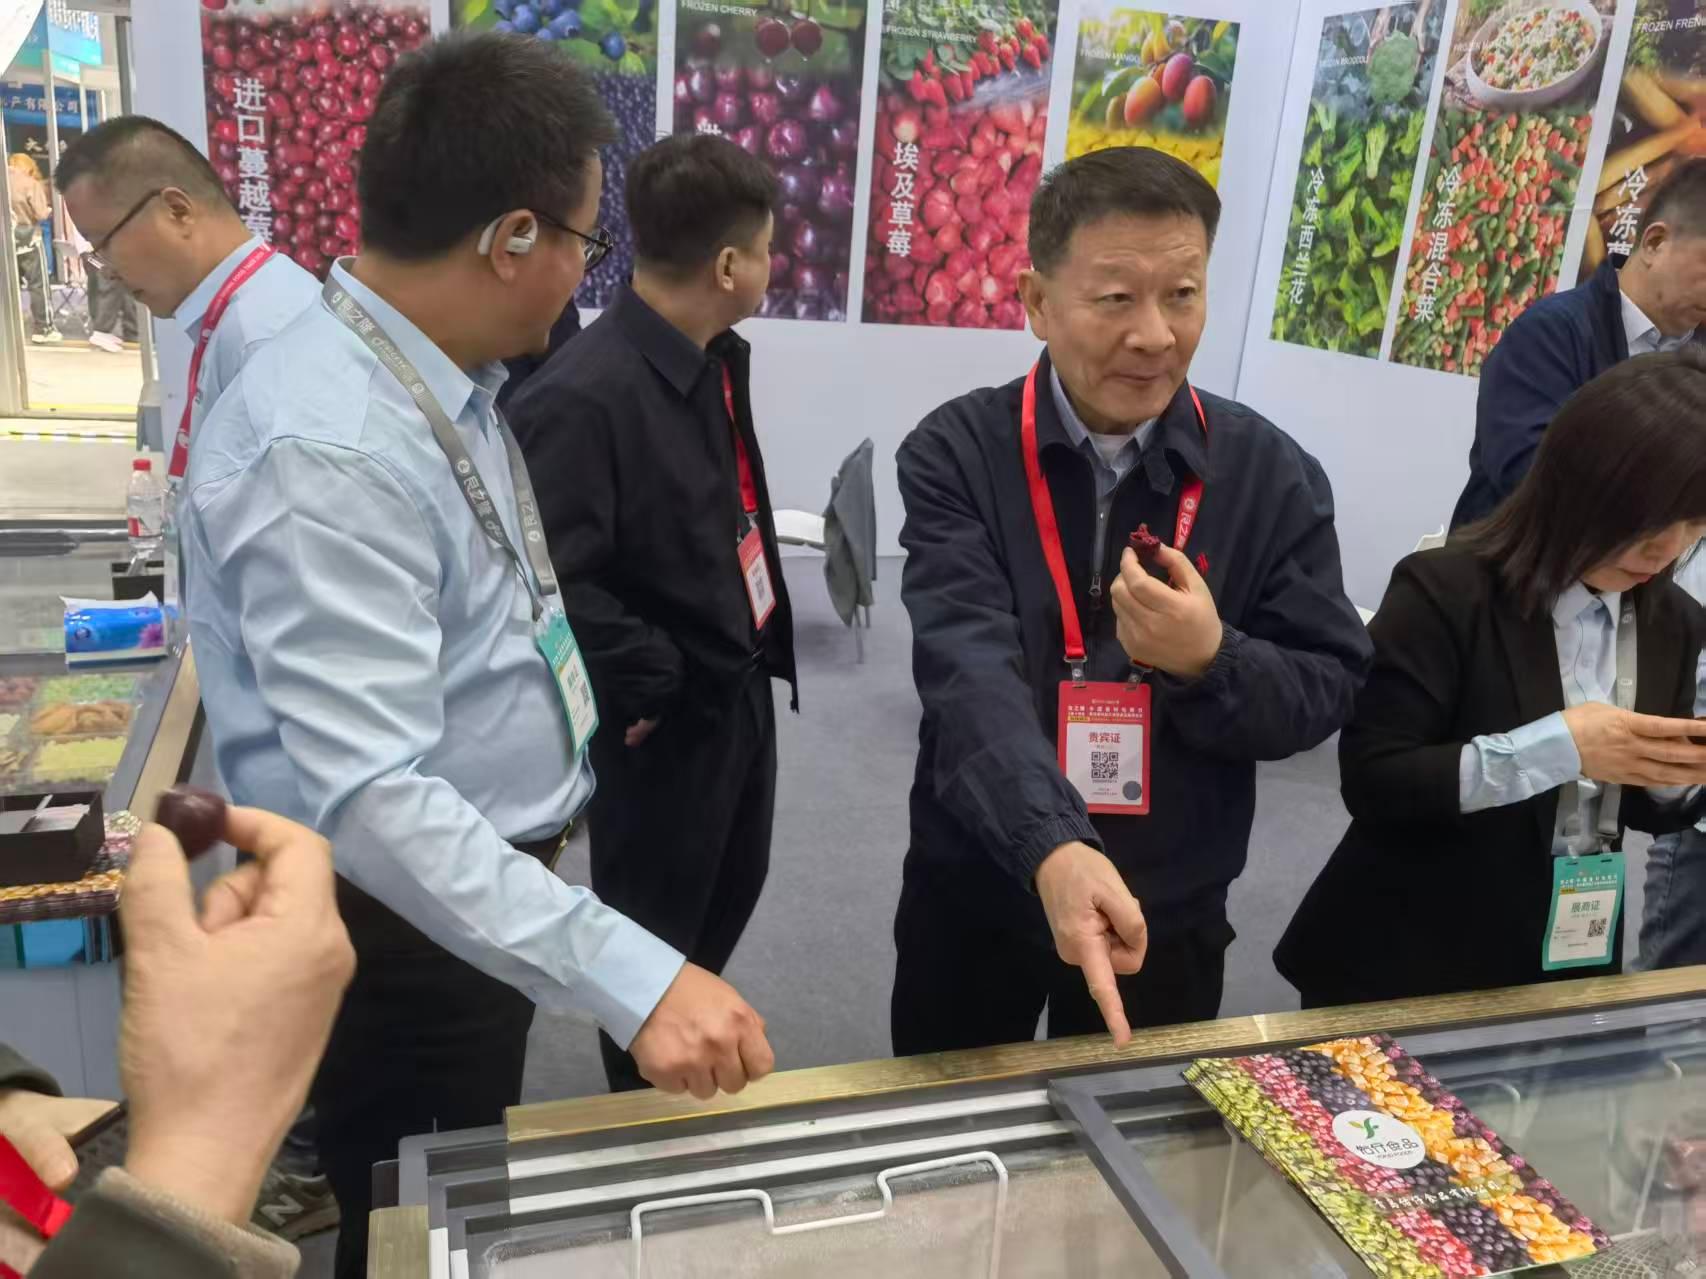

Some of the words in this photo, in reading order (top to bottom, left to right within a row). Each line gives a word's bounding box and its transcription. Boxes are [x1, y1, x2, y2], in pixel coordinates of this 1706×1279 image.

[720, 5, 758, 17] CHERRY
[1637, 19, 1675, 33] FROZEN
[886, 141, 919, 257] 埃及草莓
[1290, 167, 1325, 305] 冷冻西兰花
[1088, 731, 1121, 744] 贵宾证
